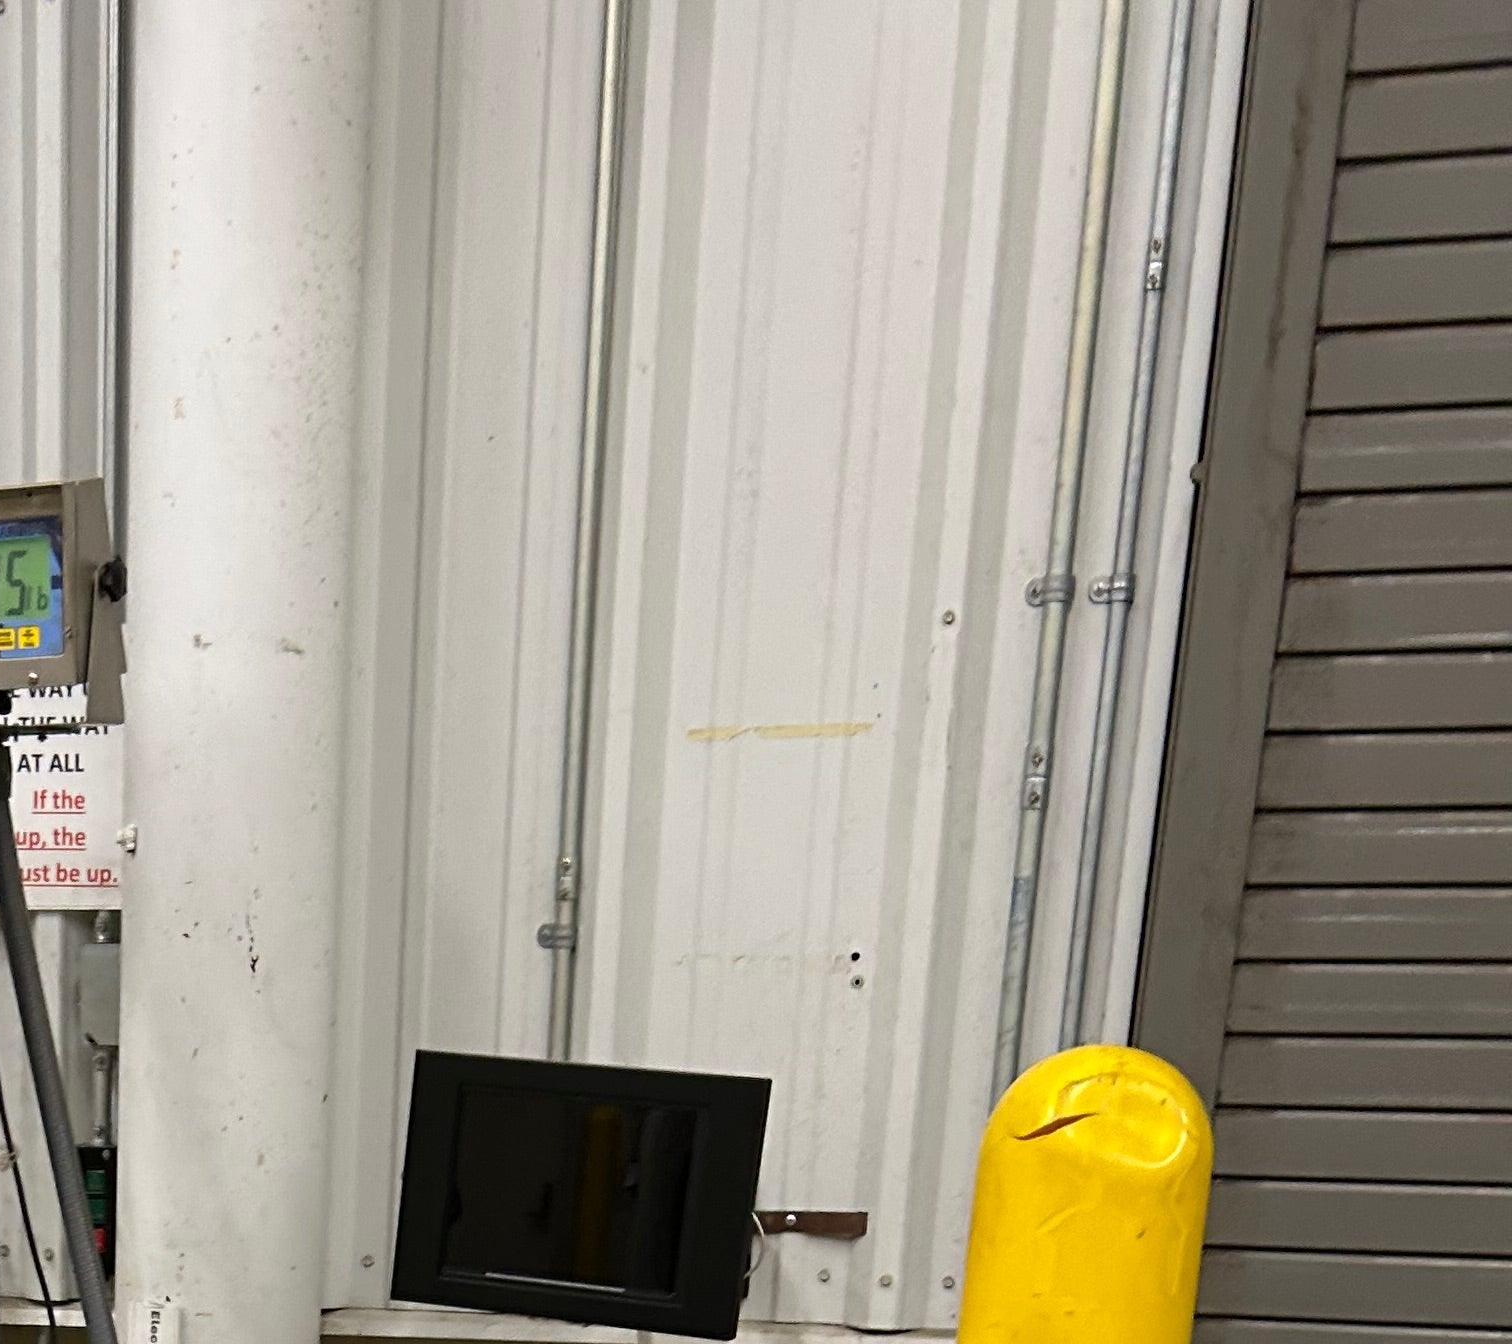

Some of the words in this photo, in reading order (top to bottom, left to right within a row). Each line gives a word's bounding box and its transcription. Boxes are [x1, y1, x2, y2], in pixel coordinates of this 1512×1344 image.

[16, 753, 42, 773] AT
[48, 753, 85, 773] ALL
[32, 789, 48, 811] If
[52, 789, 86, 811] the
[15, 830, 47, 849] up,
[53, 827, 87, 847] the
[19, 866, 50, 883] ust
[56, 863, 81, 883] be
[87, 868, 119, 888] up.
